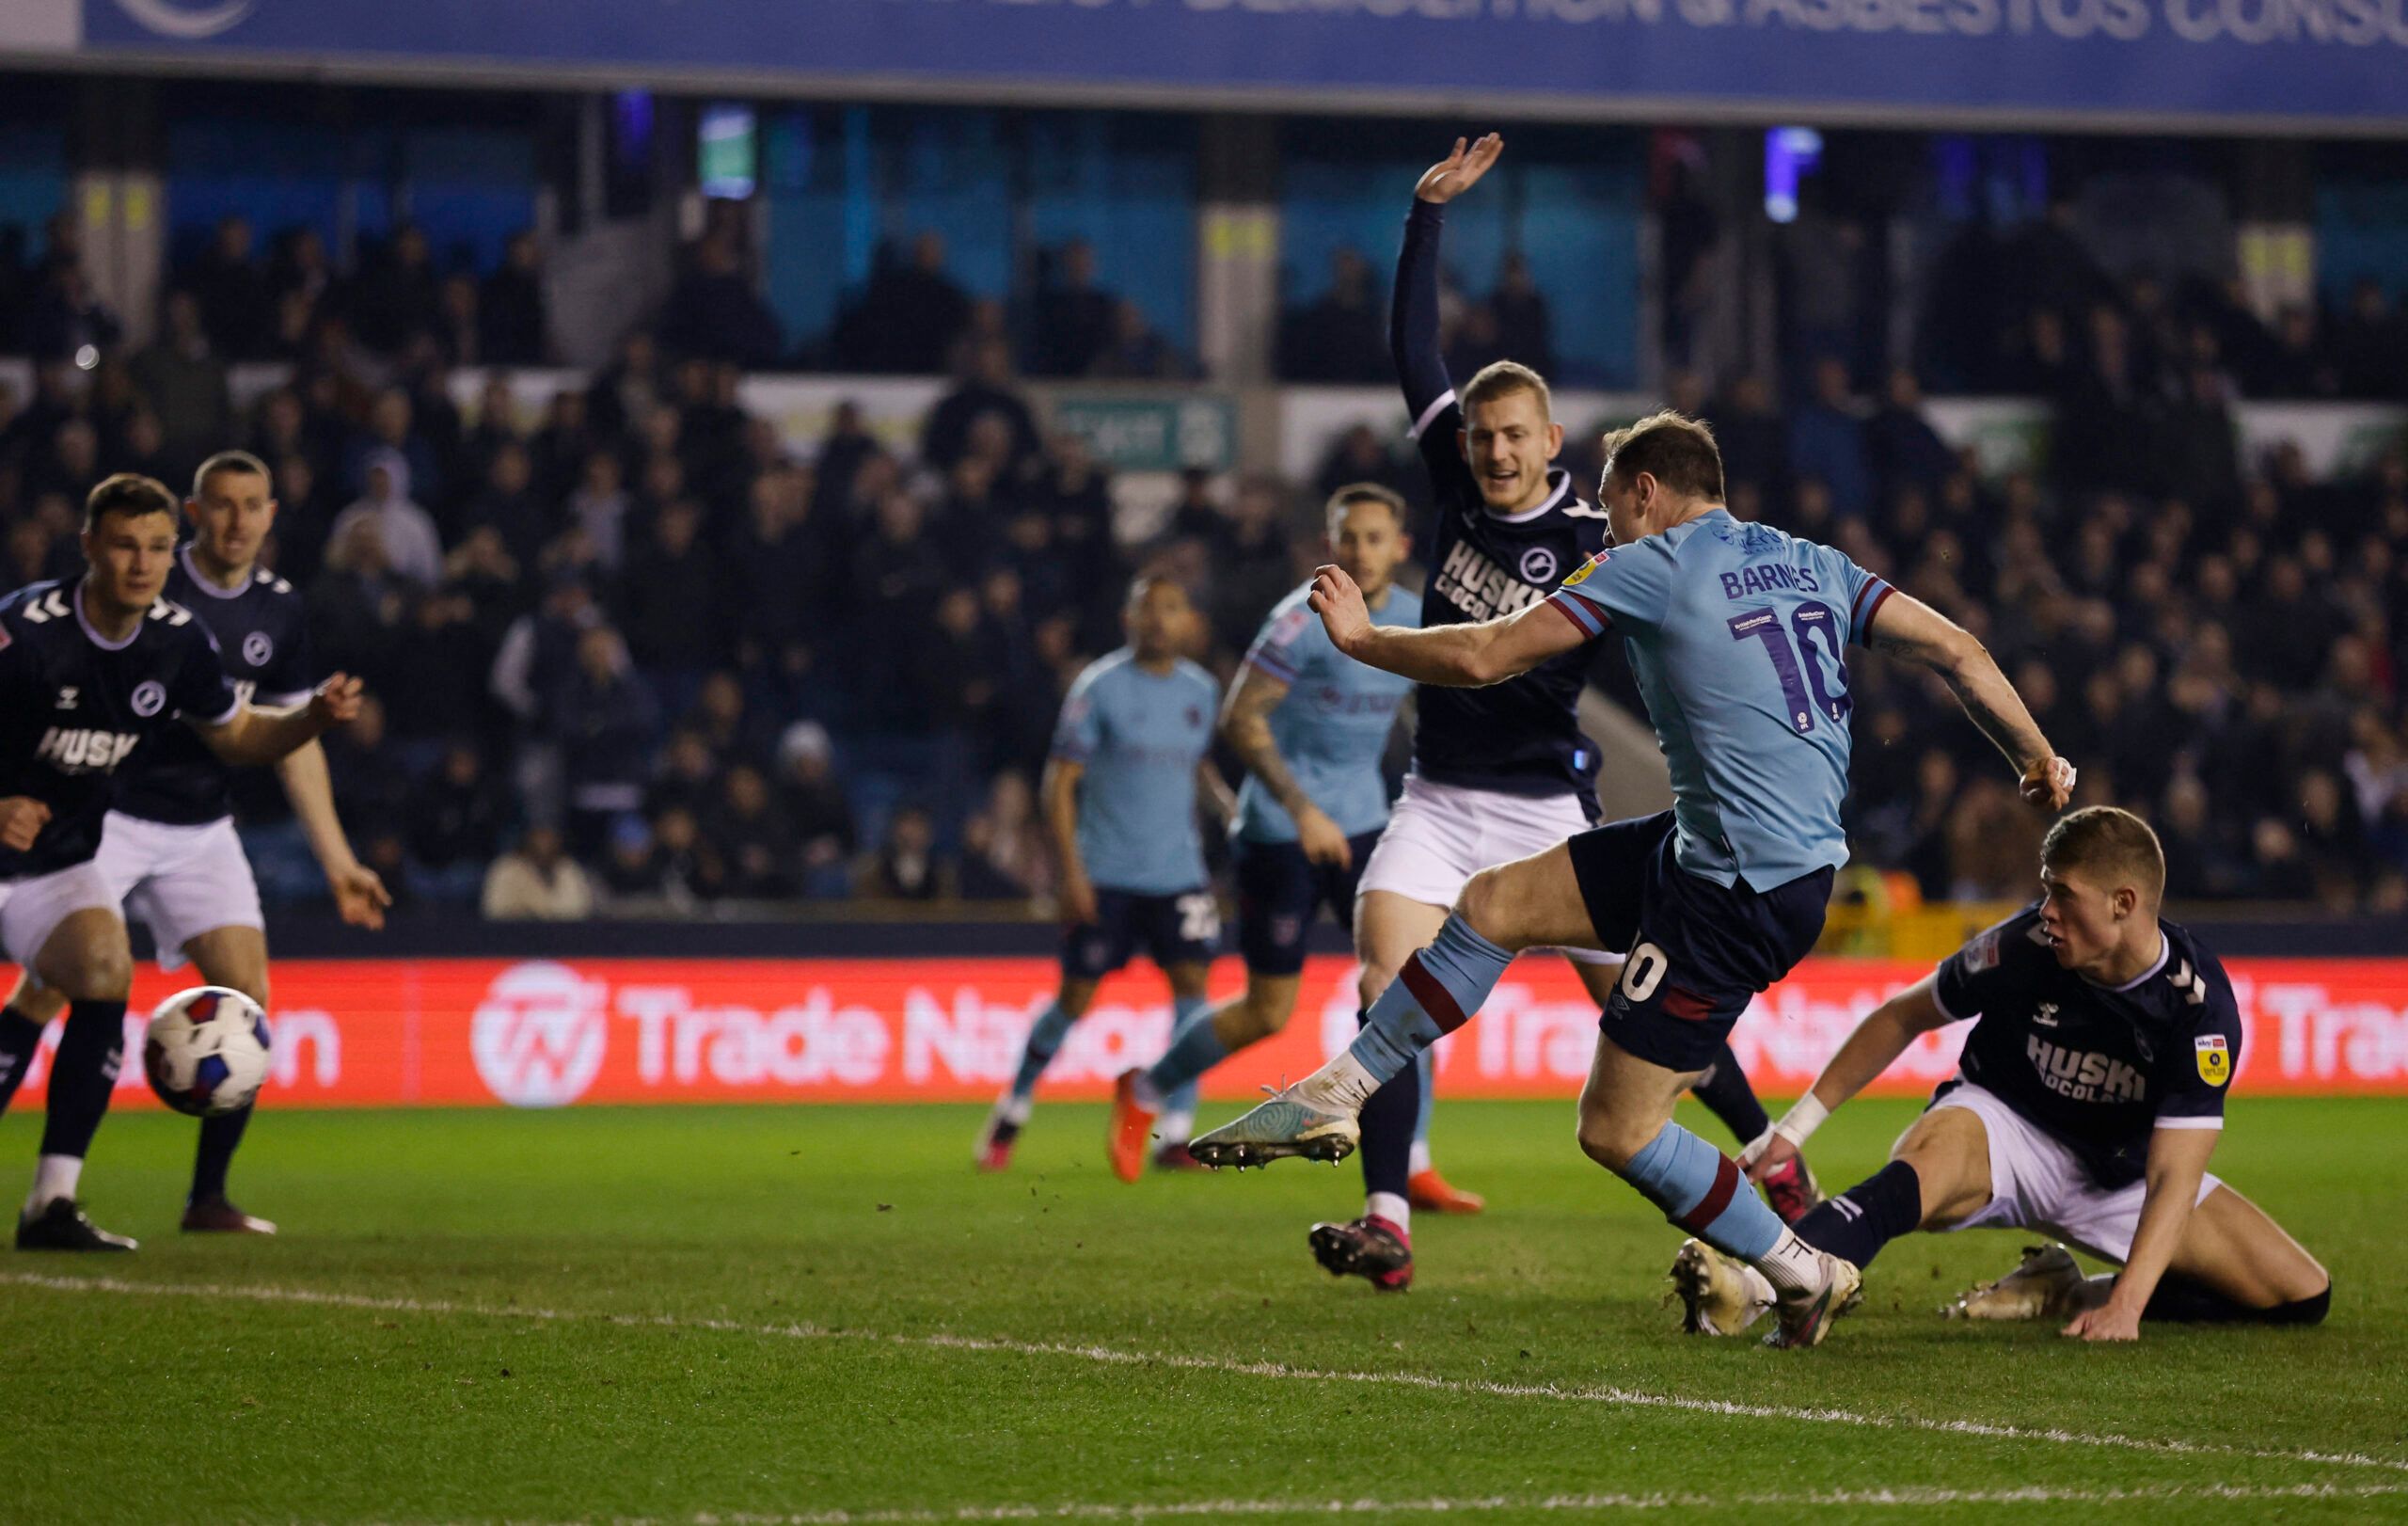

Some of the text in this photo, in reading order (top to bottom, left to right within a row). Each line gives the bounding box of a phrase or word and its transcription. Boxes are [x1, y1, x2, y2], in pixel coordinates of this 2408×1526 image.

[2166, 0, 2408, 45] CONS
[1719, 564, 1819, 599] BARNES
[1726, 601, 1853, 734] 10
[38, 726, 140, 767] HUSK
[1616, 927, 1668, 1002] 0
[615, 984, 891, 1086] Trade
[1475, 982, 1602, 1079] Tra
[2027, 1034, 2146, 1102] HUSKI
[2260, 982, 2408, 1080] Tra
